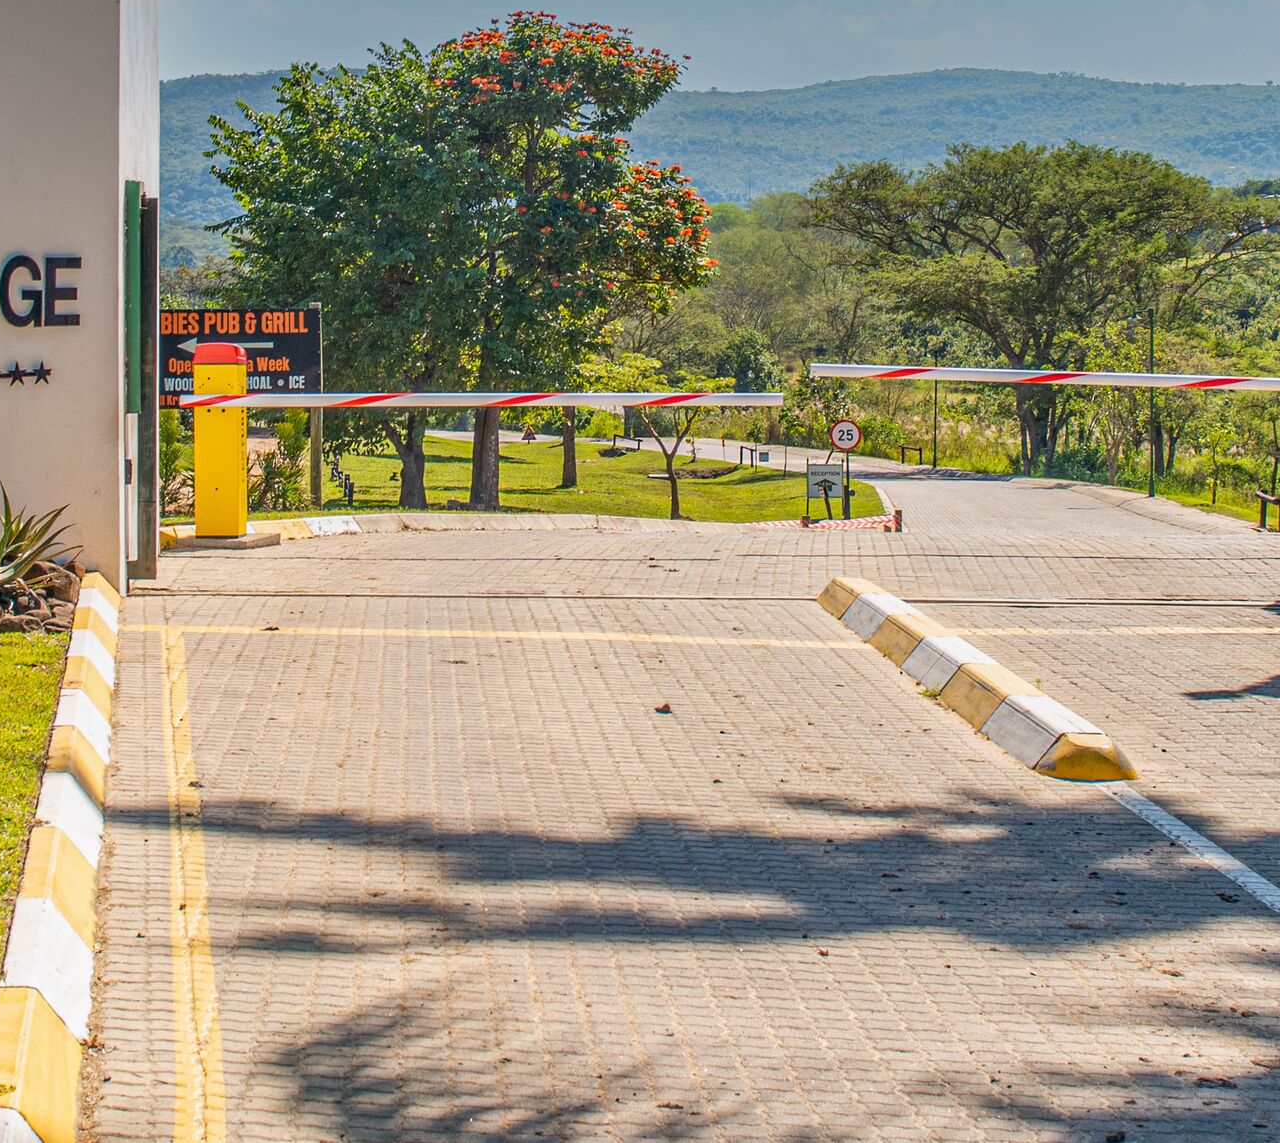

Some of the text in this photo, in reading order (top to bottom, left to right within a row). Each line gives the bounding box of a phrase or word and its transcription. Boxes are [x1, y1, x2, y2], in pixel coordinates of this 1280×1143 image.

[160, 311, 309, 335] BIES PUB & GRILL
[168, 357, 195, 375] Ope
[256, 356, 290, 372] Week
[288, 375, 306, 390] ICE
[837, 429, 854, 442] 25
